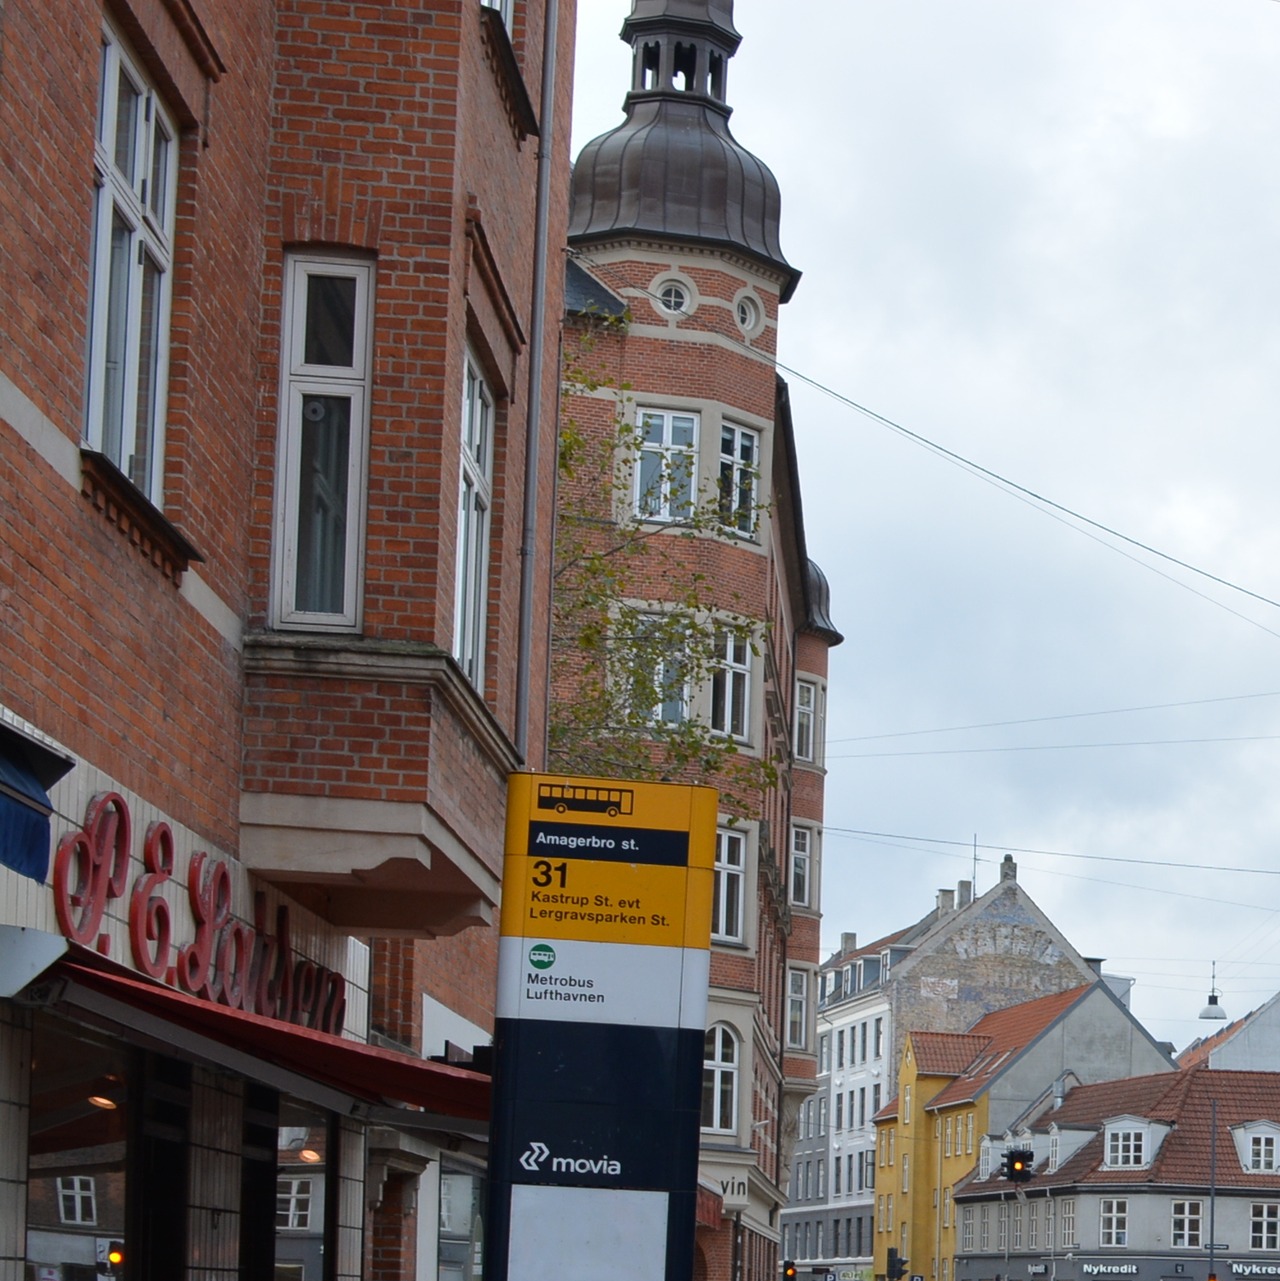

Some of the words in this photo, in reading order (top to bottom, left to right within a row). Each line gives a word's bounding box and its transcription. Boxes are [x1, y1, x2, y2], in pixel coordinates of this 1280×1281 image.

[536, 831, 615, 850] Amagerbro
[621, 838, 640, 851] st.
[531, 860, 567, 888] 31
[531, 891, 589, 907] Kastrup
[594, 895, 613, 908] St.
[618, 898, 641, 910] evt
[529, 908, 646, 926] Lergravsparken
[651, 915, 670, 927] St.
[527, 973, 594, 989] Metrobus
[526, 989, 605, 1003] Lufthavnen
[551, 1154, 622, 1176] movia
[720, 1176, 746, 1195] vin
[1083, 1263, 1138, 1275] Nykredit
